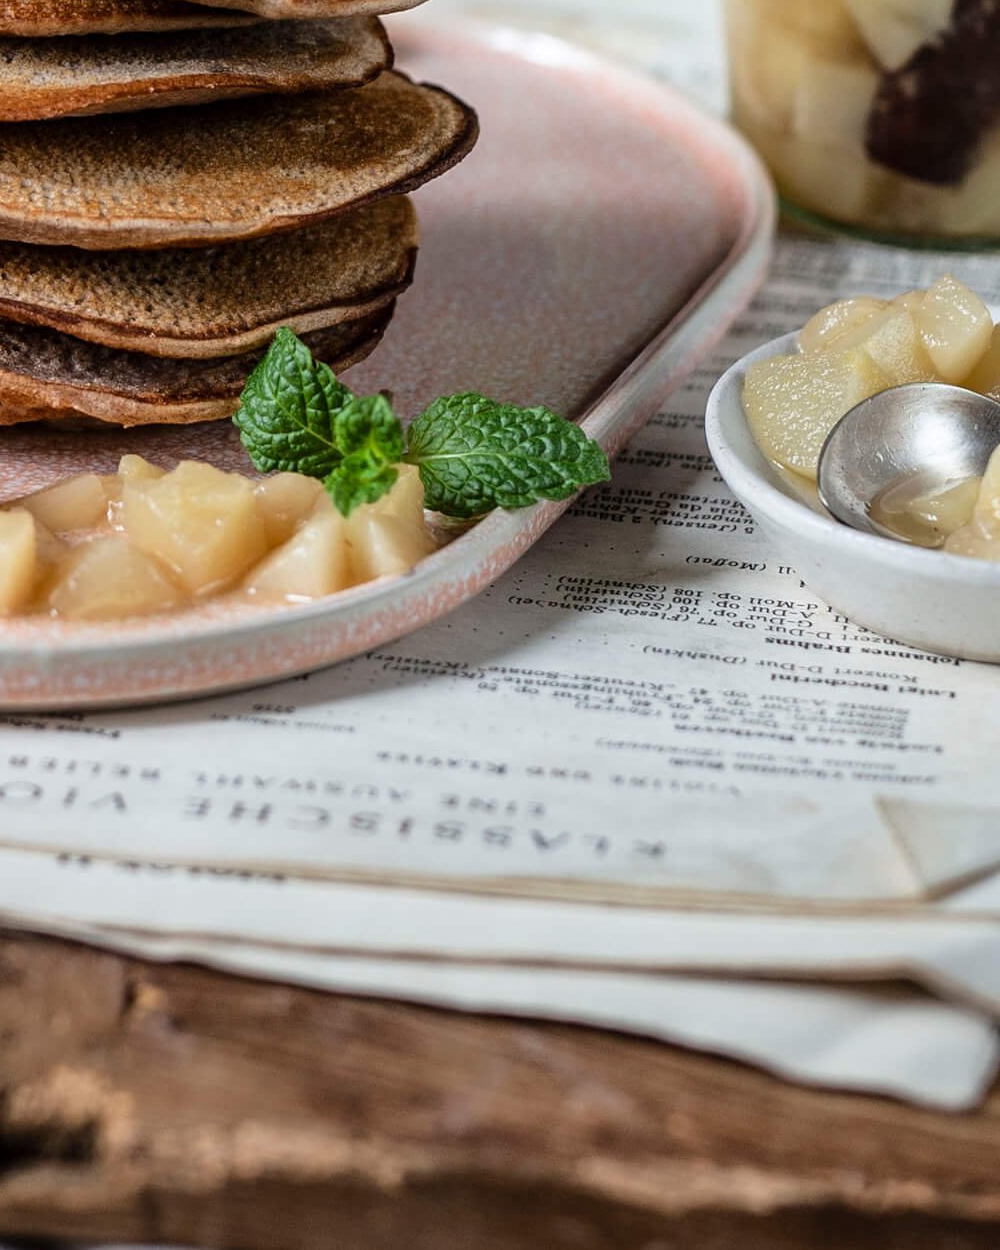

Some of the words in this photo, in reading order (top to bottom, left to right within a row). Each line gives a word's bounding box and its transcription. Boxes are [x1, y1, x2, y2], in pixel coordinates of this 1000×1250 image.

[593, 493, 671, 509] Gamba)
[678, 502, 702, 512] da
[744, 526, 754, 535] 5
[684, 555, 767, 573] (Moffat)
[558, 575, 667, 594] (Schnirlin)
[555, 584, 665, 603] (Schnirlin)
[672, 595, 700, 605] 100
[674, 588, 704, 598] 108
[711, 590, 741, 601] op.
[562, 593, 672, 612] (Schnirlin)
[710, 600, 740, 611] op.
[749, 597, 818, 610] d-Moll
[707, 608, 737, 619] op.
[748, 605, 815, 619] A-Dur
[697, 616, 718, 627] 77
[726, 619, 756, 630] op.
[745, 614, 813, 628] G-Dur
[764, 625, 832, 640] D-Dur
[764, 637, 851, 654] Brahms
[365, 652, 468, 671] (Kreisler)
[642, 645, 746, 665] (Dushkin)
[860, 647, 962, 666] Johannes
[382, 662, 485, 680] (Kreisler)
[755, 660, 823, 674] D-Dur
[769, 673, 889, 692] Boccherini
[835, 667, 919, 684] Konzert
[688, 687, 708, 696] 47
[899, 684, 957, 698] Luigi
[692, 696, 713, 705] 24
[758, 693, 827, 708] A-Dur
[837, 701, 910, 715] Sonate
[674, 723, 794, 743] Beethoven
[196, 774, 409, 803] AUSWAHL
[442, 793, 545, 818] EINE
[184, 797, 664, 863] KLASSISCHE
